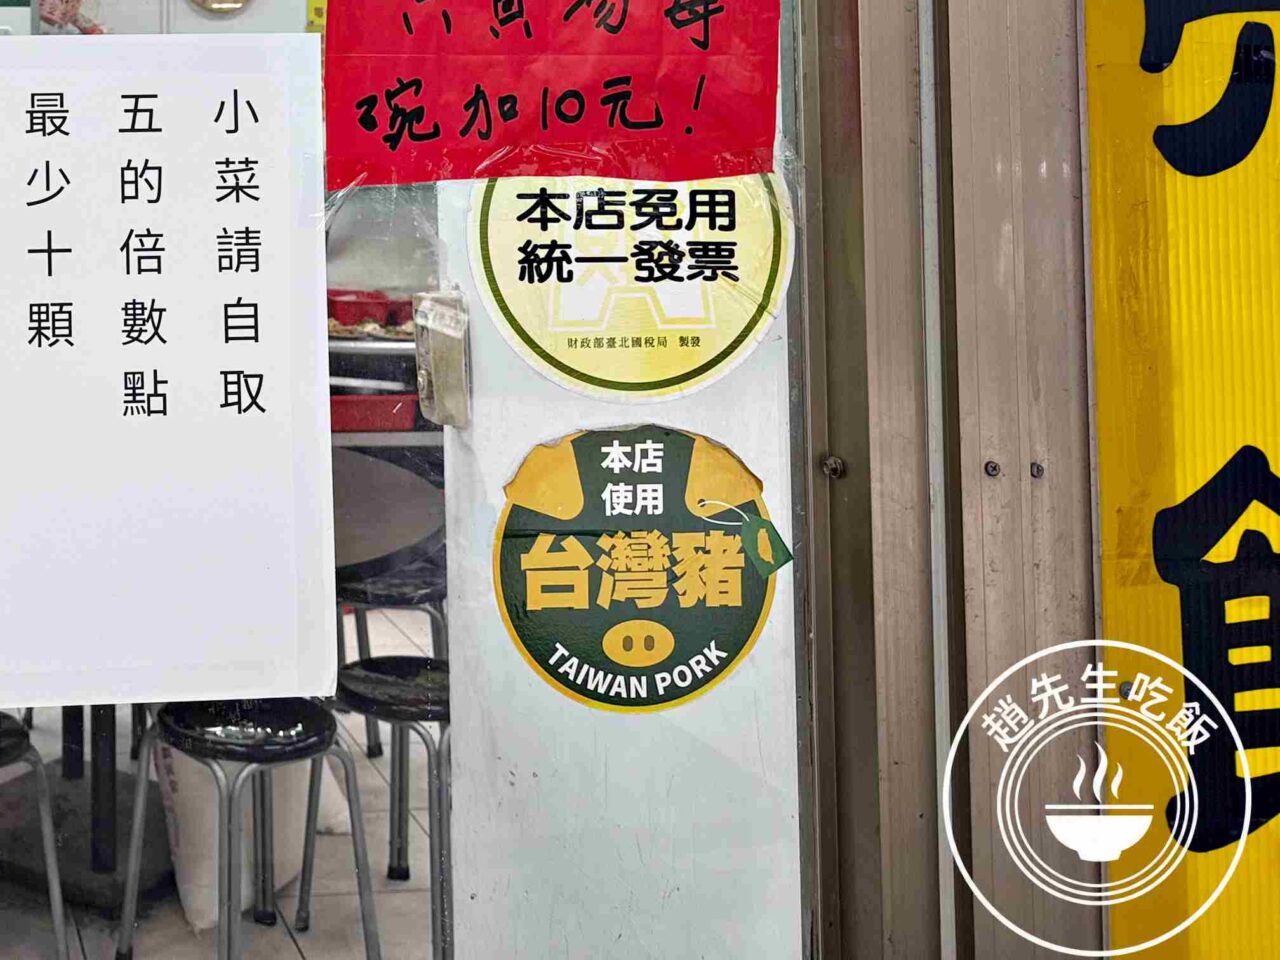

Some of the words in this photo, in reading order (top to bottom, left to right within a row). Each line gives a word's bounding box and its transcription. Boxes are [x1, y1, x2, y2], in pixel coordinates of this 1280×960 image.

[25, 92, 75, 348] 最少十顆
[516, 187, 737, 232] 本店免用
[118, 93, 169, 417] 五的倍數點
[214, 89, 266, 415] 小菜請自取
[517, 239, 740, 284] 統一發票
[600, 440, 665, 474] 本店
[601, 482, 665, 516] 使用
[520, 528, 747, 611] 台灣豬
[548, 642, 647, 698] TAIWAN
[654, 640, 728, 696] PORK
